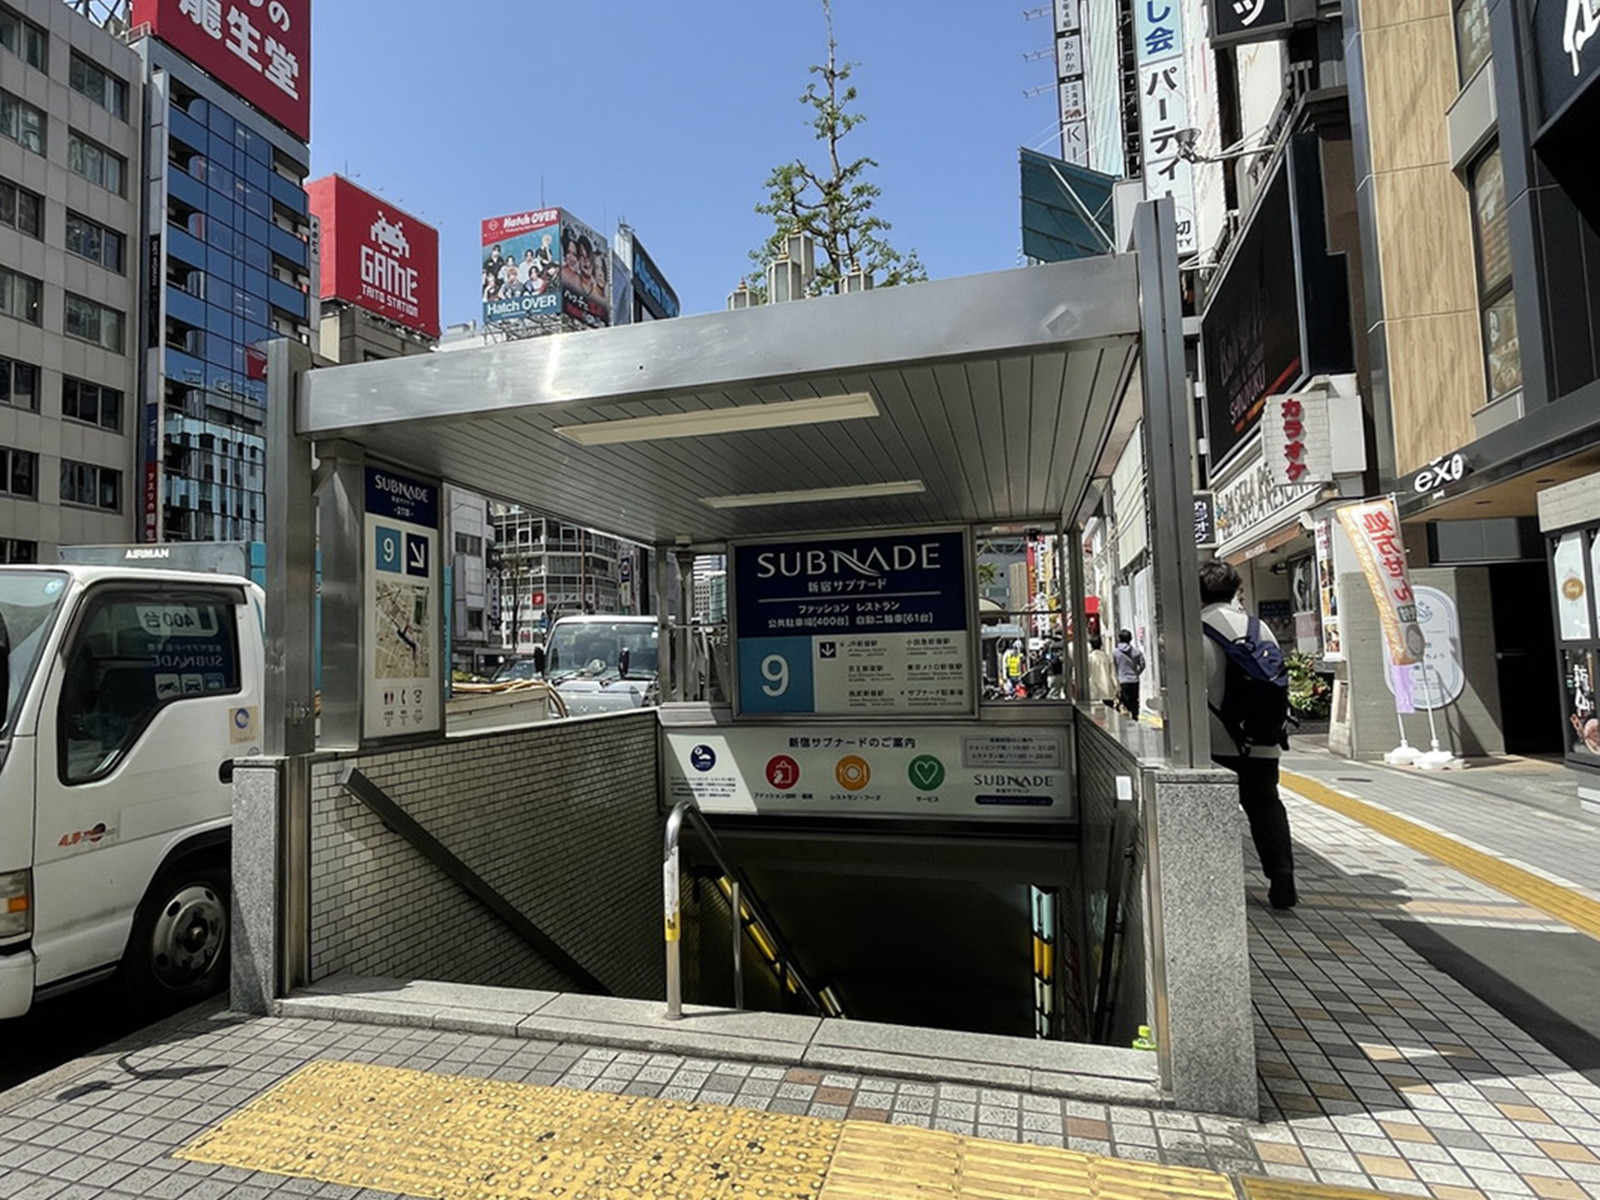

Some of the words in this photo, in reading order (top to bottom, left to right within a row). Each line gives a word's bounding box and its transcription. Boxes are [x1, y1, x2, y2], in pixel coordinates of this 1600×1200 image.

[531, 209, 558, 223] OVER
[361, 245, 418, 304] GAME
[362, 284, 385, 303] TAITO
[387, 295, 418, 317] STATION
[487, 301, 520, 314] Hatch
[522, 295, 556, 310] OVER
[1281, 399, 1307, 482] カラオケ
[374, 474, 428, 503] SUBNADE
[125, 549, 169, 559] AIRMAN
[384, 537, 395, 562] 9
[757, 542, 941, 578] SUBNADE
[808, 578, 887, 592] 新宿サブナード
[798, 604, 850, 614] ファッション
[856, 601, 900, 612] レストラン
[761, 654, 789, 697] 9
[789, 737, 916, 748] 新宿サブナードのご案内
[974, 774, 1054, 788] SUBNADE
